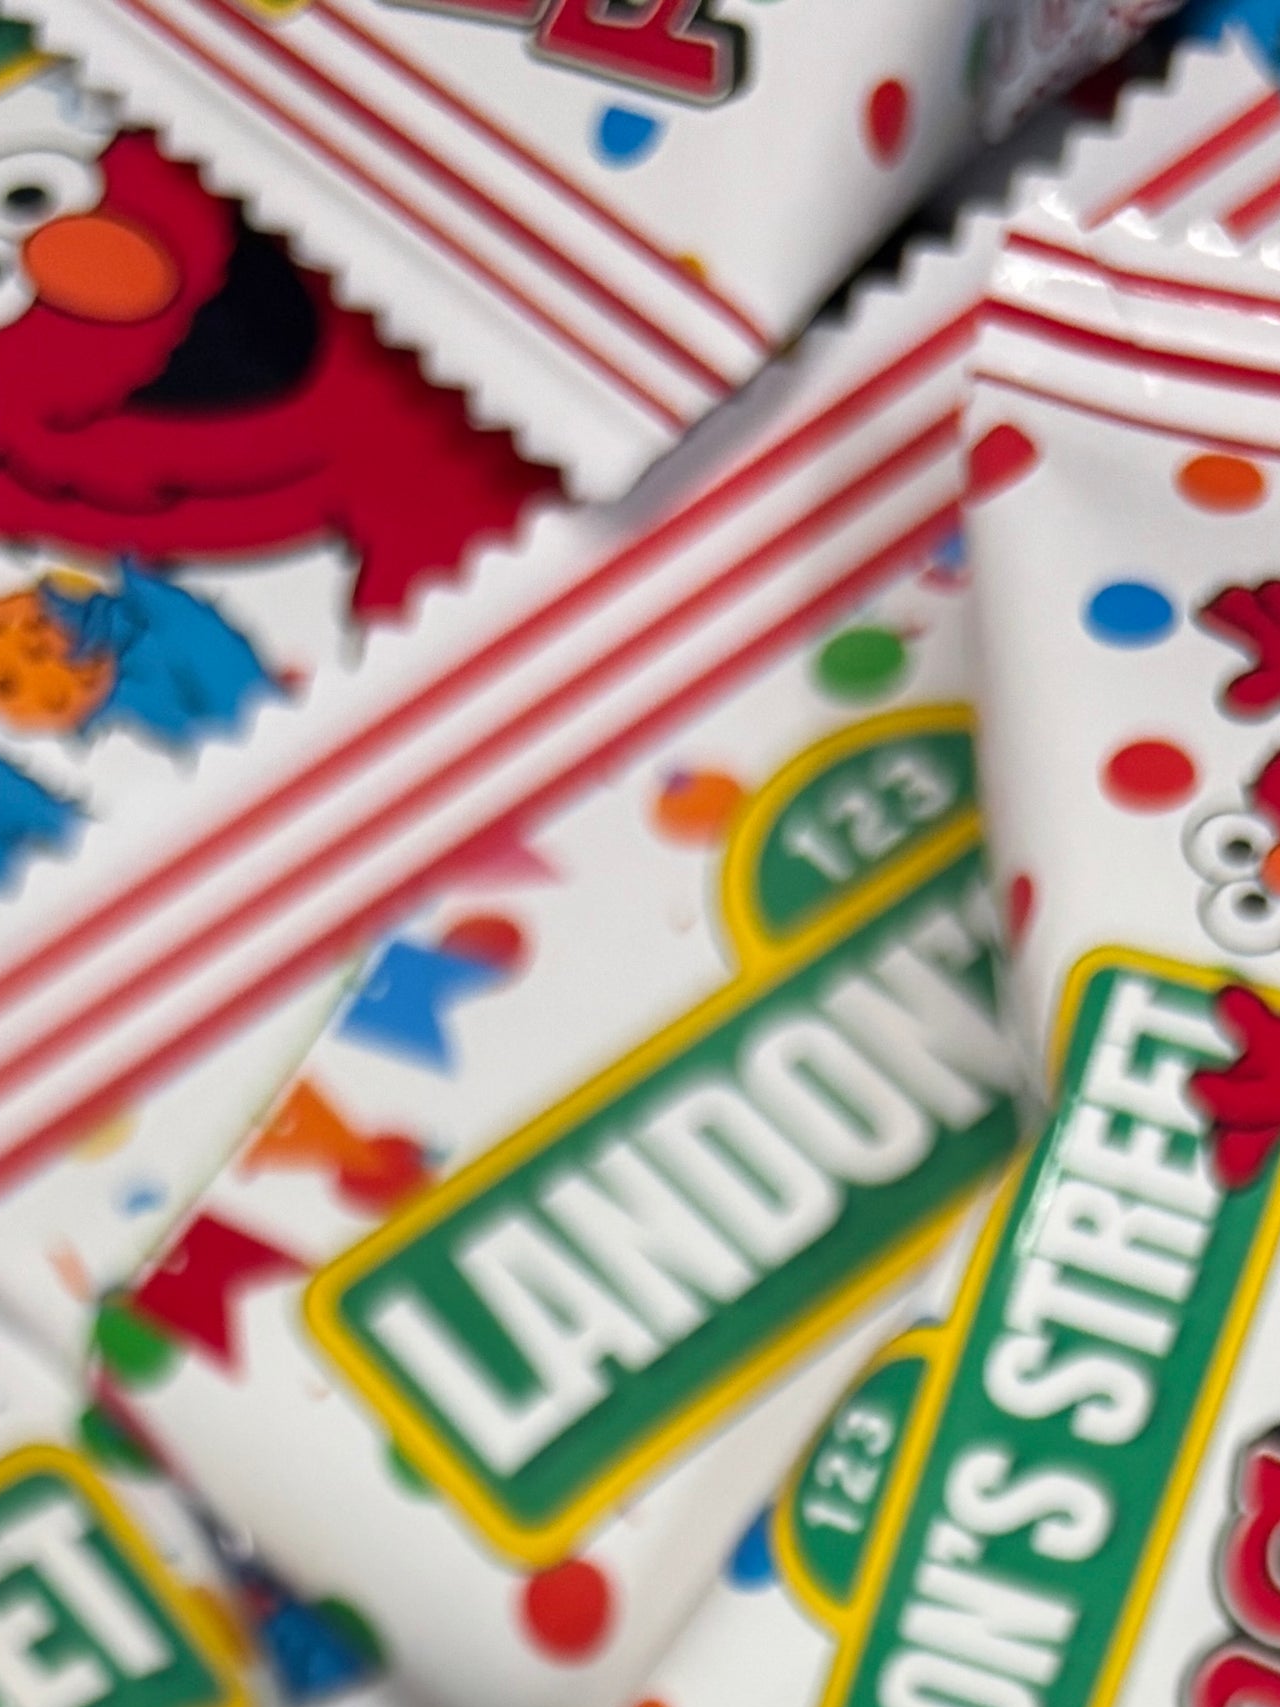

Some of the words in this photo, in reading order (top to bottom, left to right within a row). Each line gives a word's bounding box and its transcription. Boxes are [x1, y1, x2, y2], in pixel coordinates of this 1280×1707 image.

[783, 757, 958, 885] 123
[362, 880, 1025, 1480] LANDON'
[803, 1406, 896, 1536] 123
